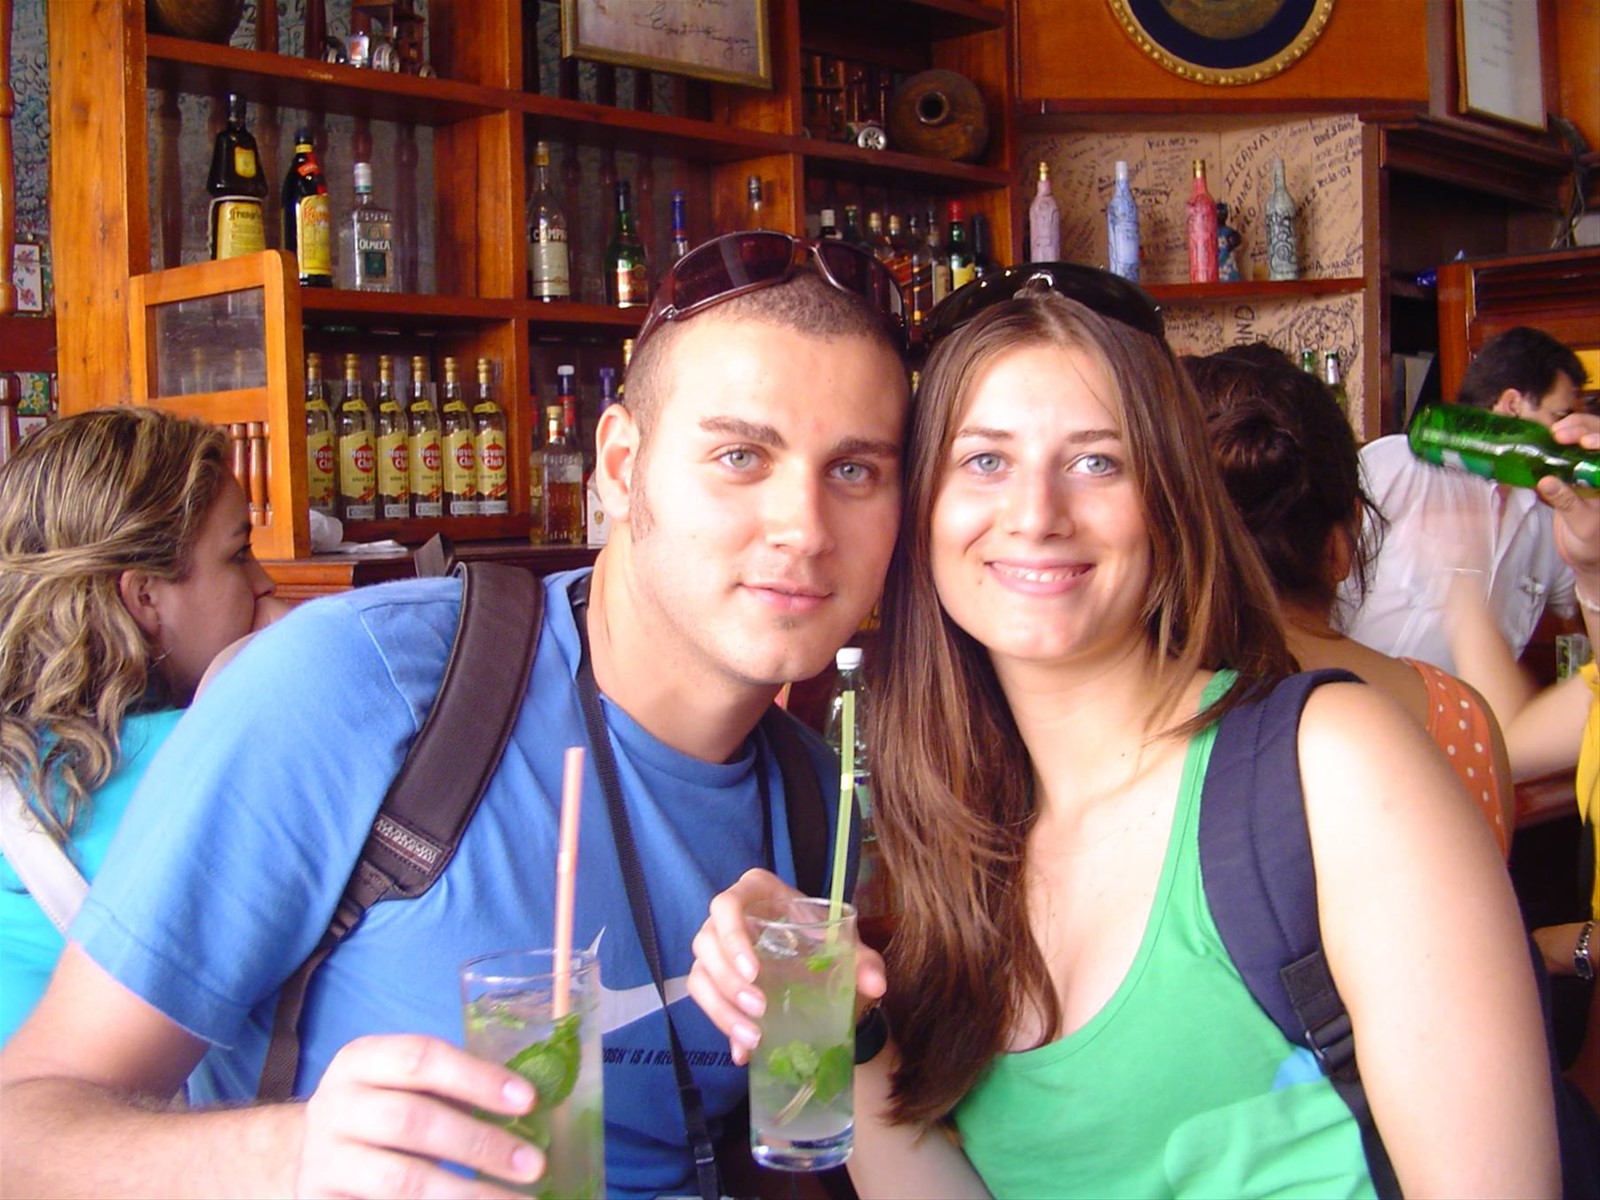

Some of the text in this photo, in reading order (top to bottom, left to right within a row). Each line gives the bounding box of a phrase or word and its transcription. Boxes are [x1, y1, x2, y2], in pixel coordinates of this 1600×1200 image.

[1225, 133, 1270, 193] ILEANA
[358, 238, 390, 251] OLMECA
[483, 456, 503, 468] Club
[629, 1049, 644, 1065] IS
[642, 1050, 654, 1065] A
